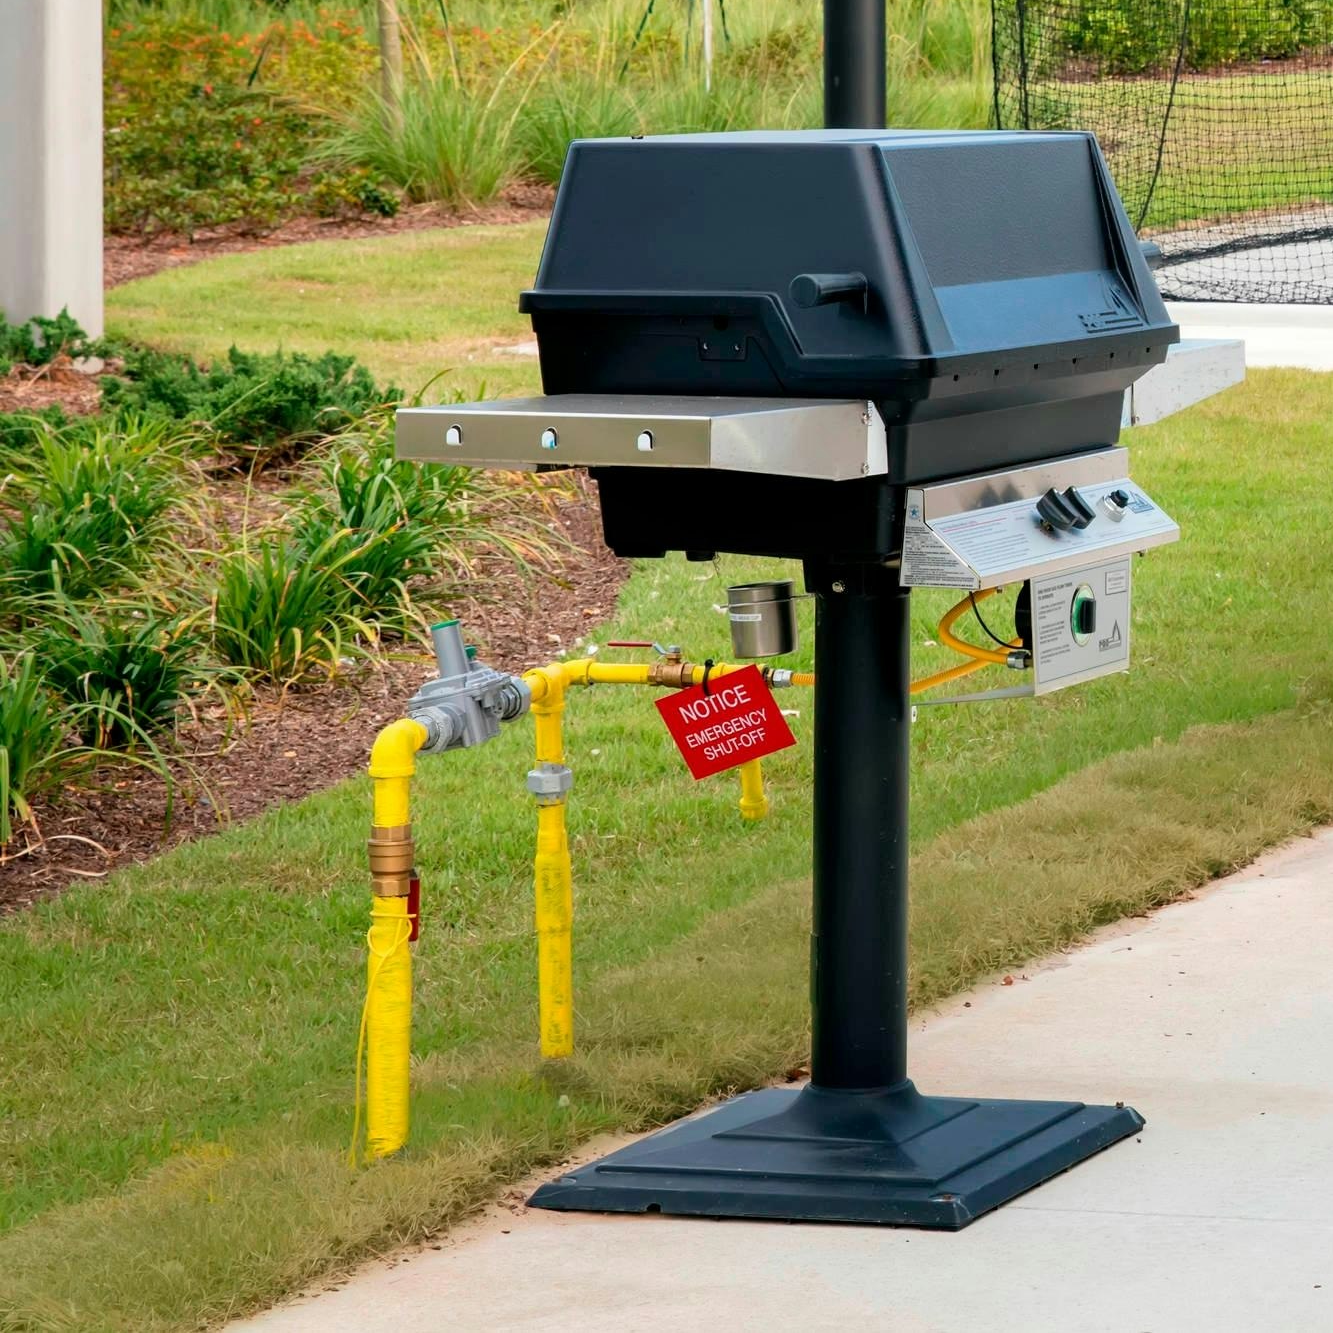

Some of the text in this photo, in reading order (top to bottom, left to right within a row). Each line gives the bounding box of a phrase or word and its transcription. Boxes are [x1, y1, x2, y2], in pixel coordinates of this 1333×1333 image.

[679, 684, 751, 724] NOTICE
[685, 708, 767, 748] EMERGENCY
[704, 728, 766, 761] SHUT-OFF
